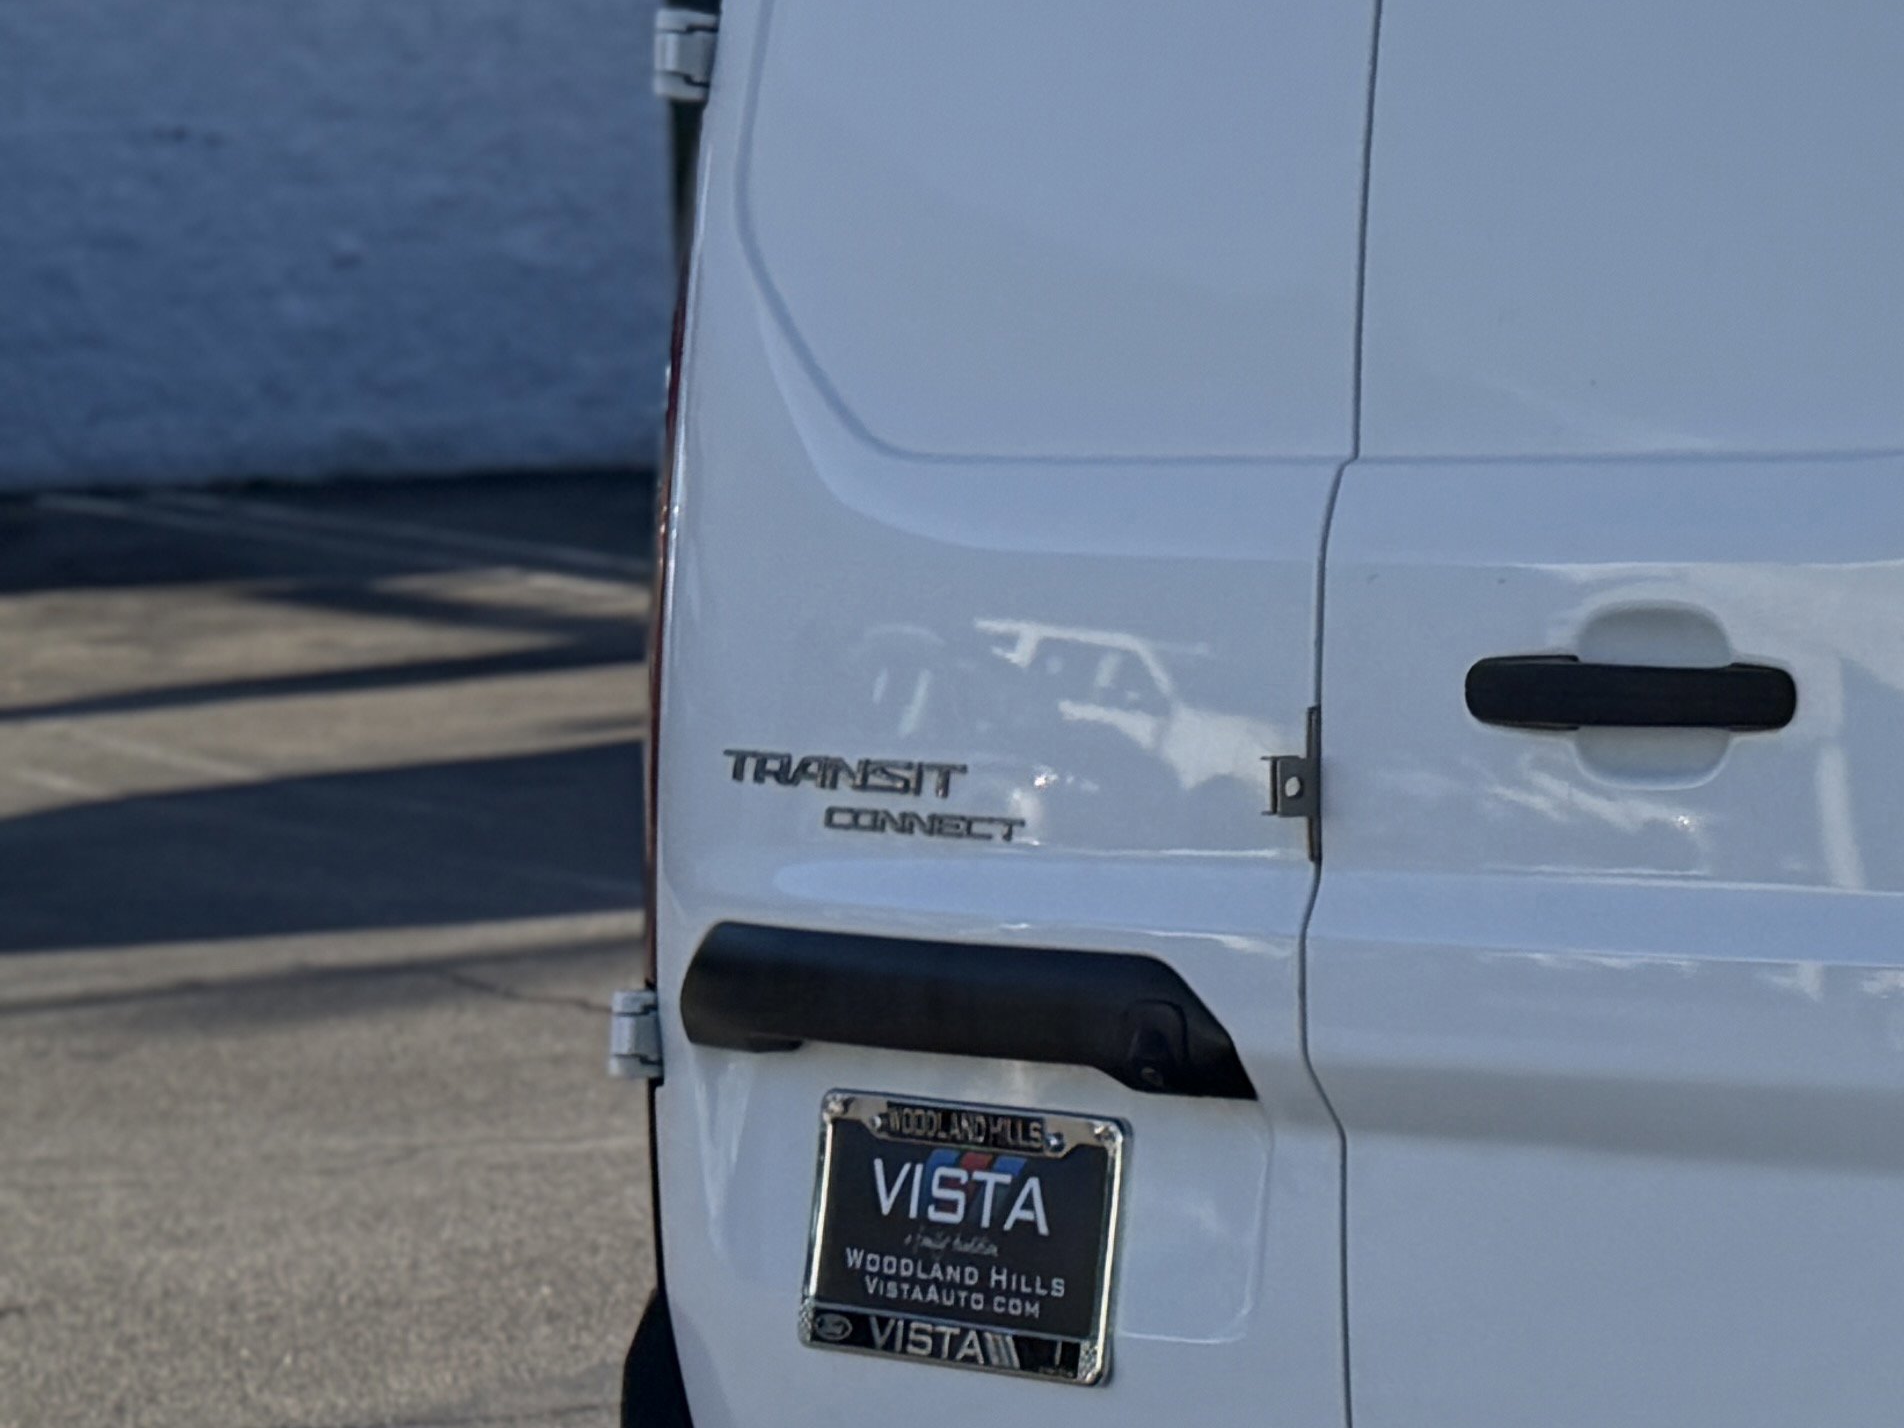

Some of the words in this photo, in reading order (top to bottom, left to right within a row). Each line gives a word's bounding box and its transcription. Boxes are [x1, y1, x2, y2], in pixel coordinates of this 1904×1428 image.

[722, 748, 969, 800] TRANSIT
[824, 805, 1027, 843] CONNECT
[887, 1105, 986, 1145] WOODLAND
[988, 1115, 1043, 1150] HILLS
[873, 1157, 1050, 1237] VISTA
[845, 1247, 980, 1287] WOODLAND
[990, 1264, 1066, 1298] HILLS
[868, 1314, 986, 1366] VISTA
